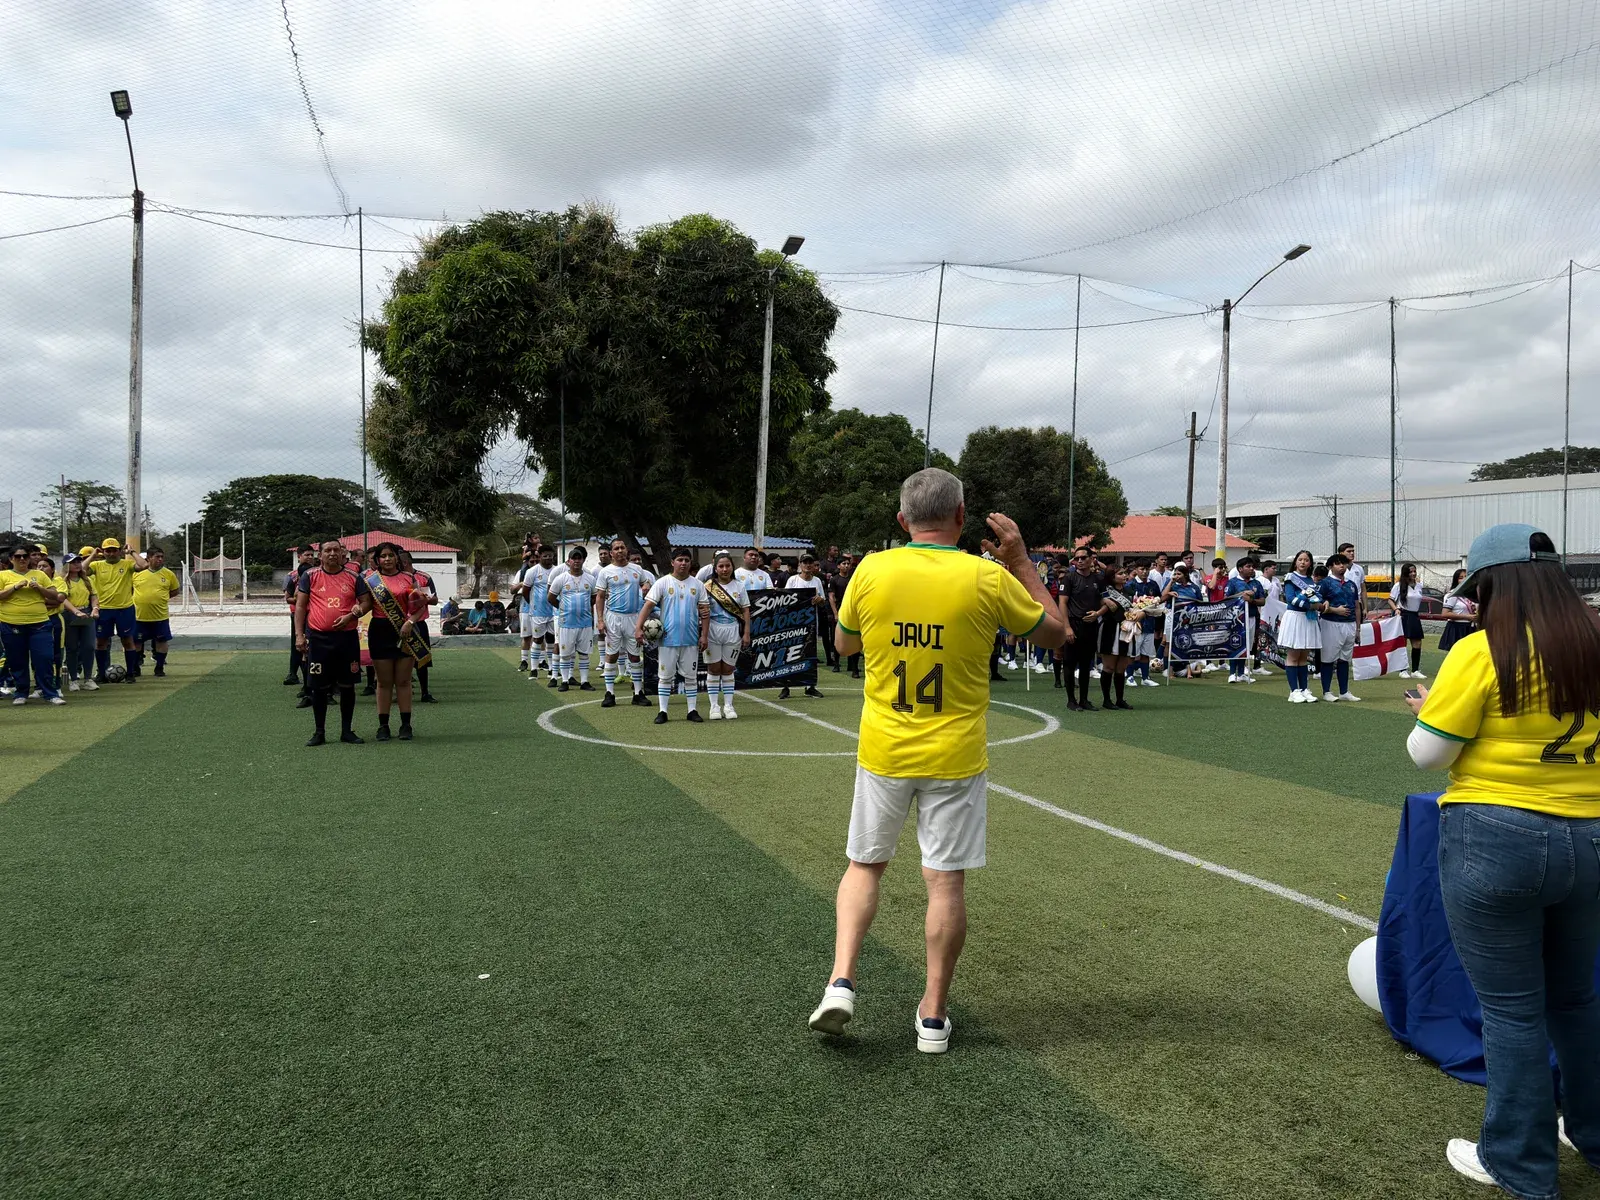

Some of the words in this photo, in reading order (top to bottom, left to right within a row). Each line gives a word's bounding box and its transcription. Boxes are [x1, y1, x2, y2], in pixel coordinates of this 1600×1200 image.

[327, 597, 341, 608] 23
[751, 593, 798, 617] SOMOS
[749, 606, 816, 636] MEJORES
[1189, 609, 1233, 624] DEPORTIVAS
[751, 627, 809, 648] PROFESIONAL
[891, 622, 944, 650] JAVI
[309, 662, 322, 675] 23
[692, 661, 697, 670] 9
[751, 671, 775, 682] PROMO
[776, 663, 806, 676] 2026-2027
[891, 660, 944, 713] 14
